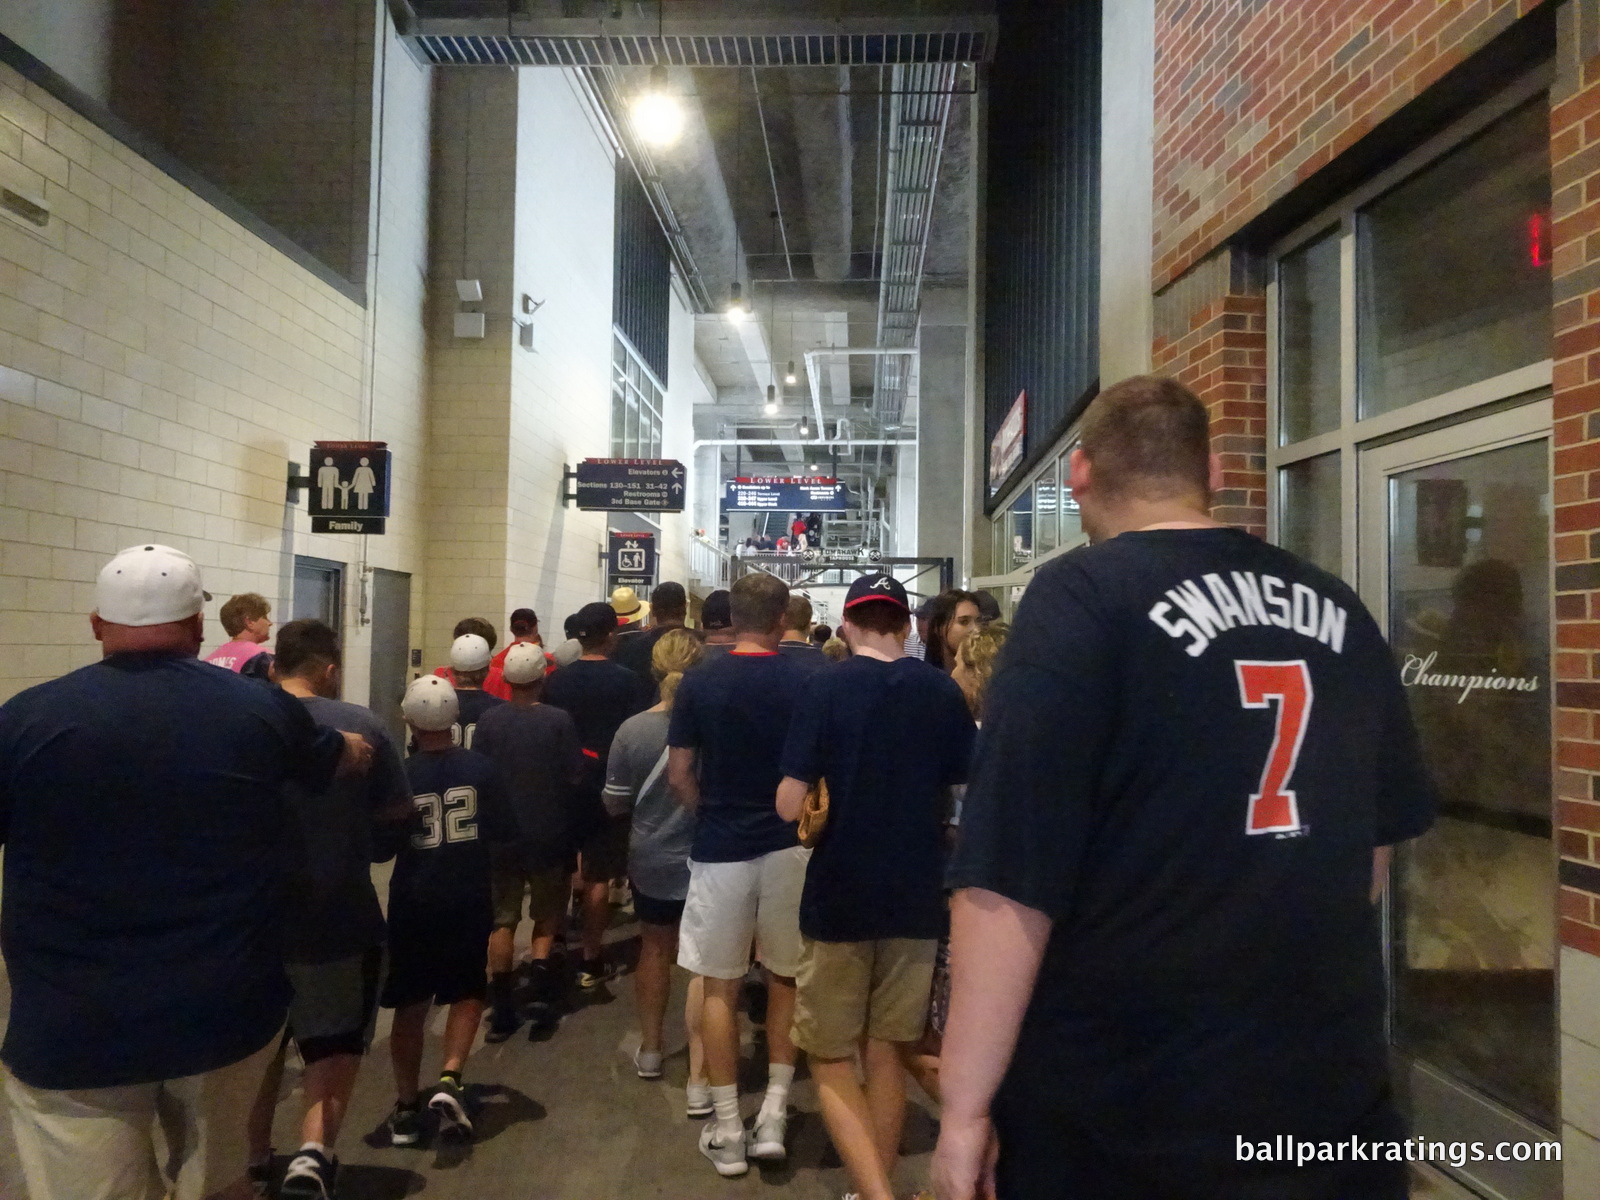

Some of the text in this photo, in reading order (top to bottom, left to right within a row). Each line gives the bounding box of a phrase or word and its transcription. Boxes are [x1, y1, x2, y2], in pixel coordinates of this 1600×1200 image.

[628, 468, 660, 476] Elevators
[577, 481, 607, 489] Sections
[623, 490, 661, 498] Restrooms
[625, 498, 642, 506] Base
[329, 521, 363, 532] Family
[820, 547, 864, 556] TOMAHAWK
[618, 576, 645, 584] Elevator
[1148, 571, 1348, 657] SWANSON
[1400, 650, 1539, 704] Champions
[1233, 659, 1314, 835] 7
[410, 785, 479, 850] 32
